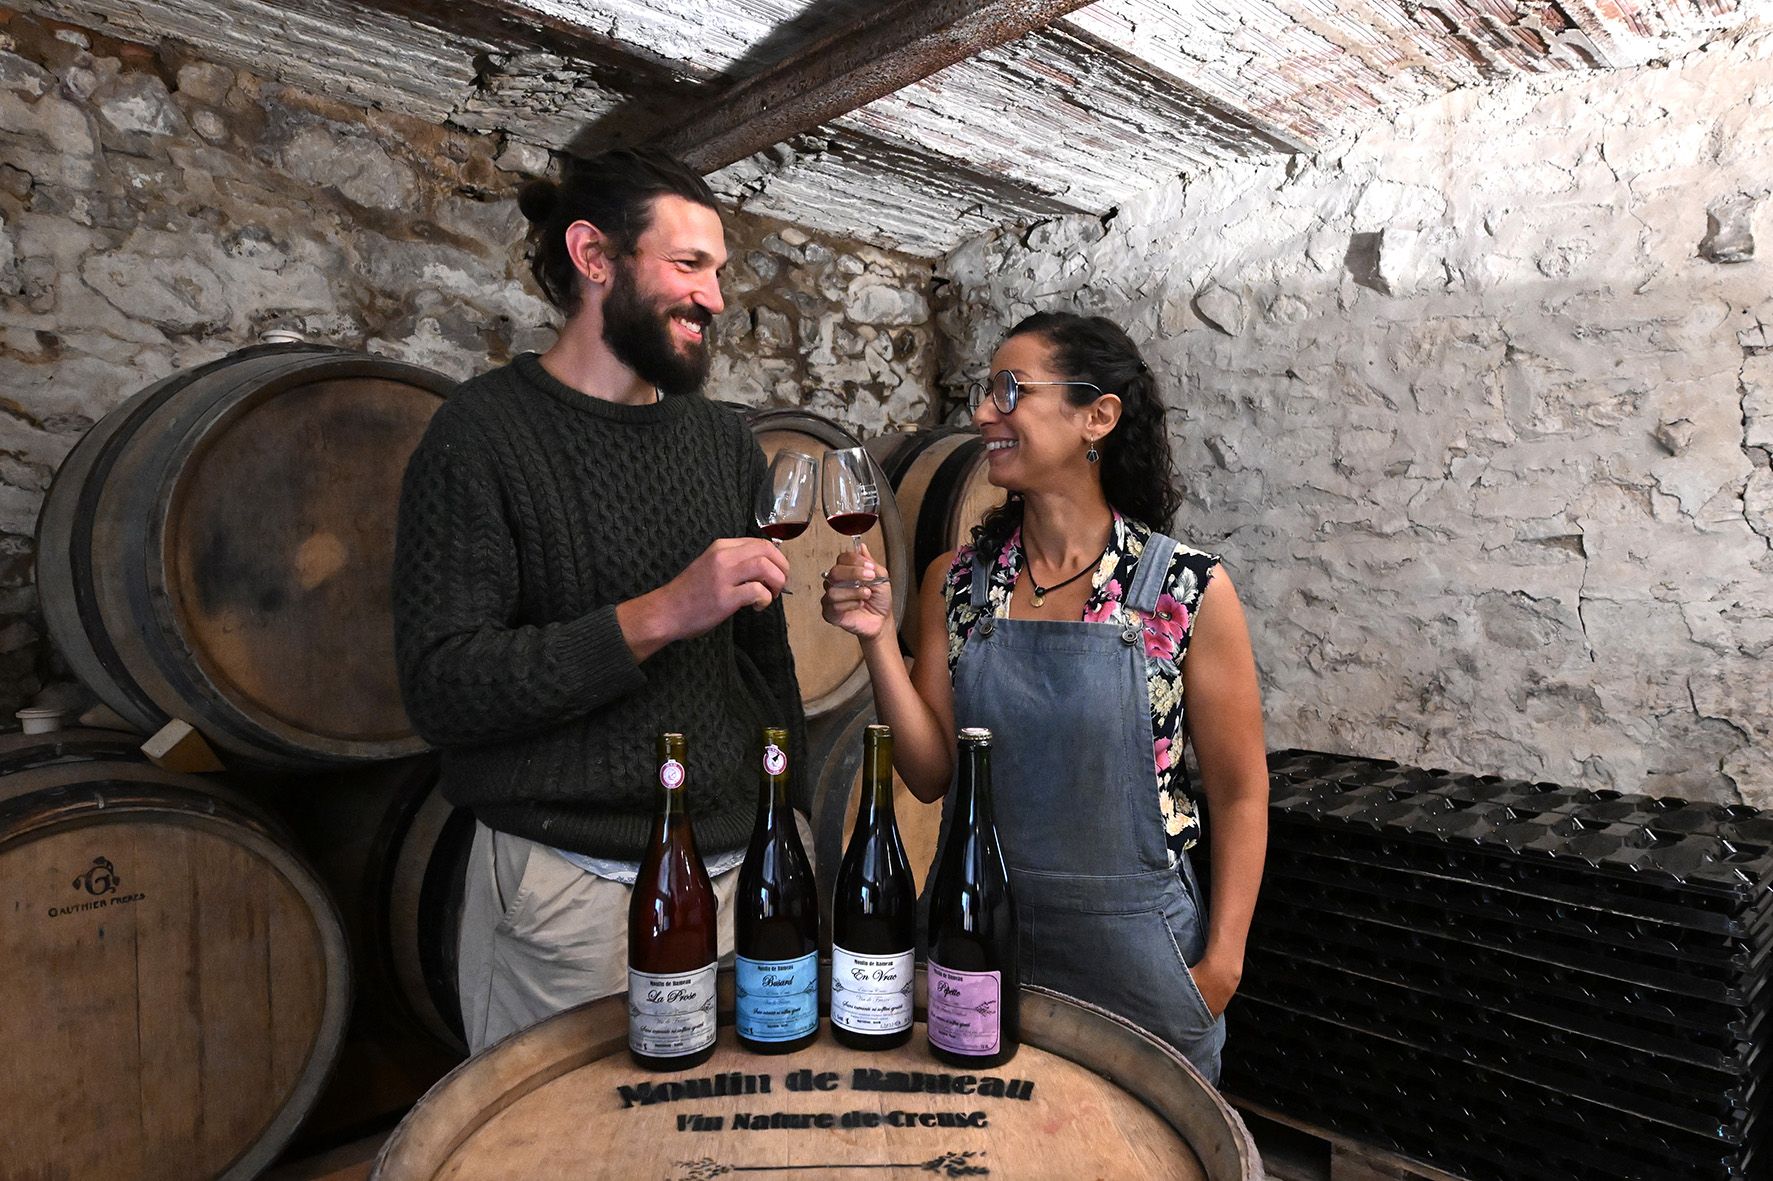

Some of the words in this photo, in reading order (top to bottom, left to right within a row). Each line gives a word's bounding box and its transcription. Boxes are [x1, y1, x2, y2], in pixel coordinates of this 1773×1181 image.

[851, 967, 869, 981] En
[872, 967, 897, 982] Vrac
[646, 989, 665, 1004] La
[616, 1072, 772, 1109] Moulin
[785, 1068, 839, 1092] de
[852, 1067, 1035, 1101] Rameau
[731, 1111, 833, 1131] Nature
[841, 1110, 881, 1129] de
[886, 1109, 989, 1129] Creuse
